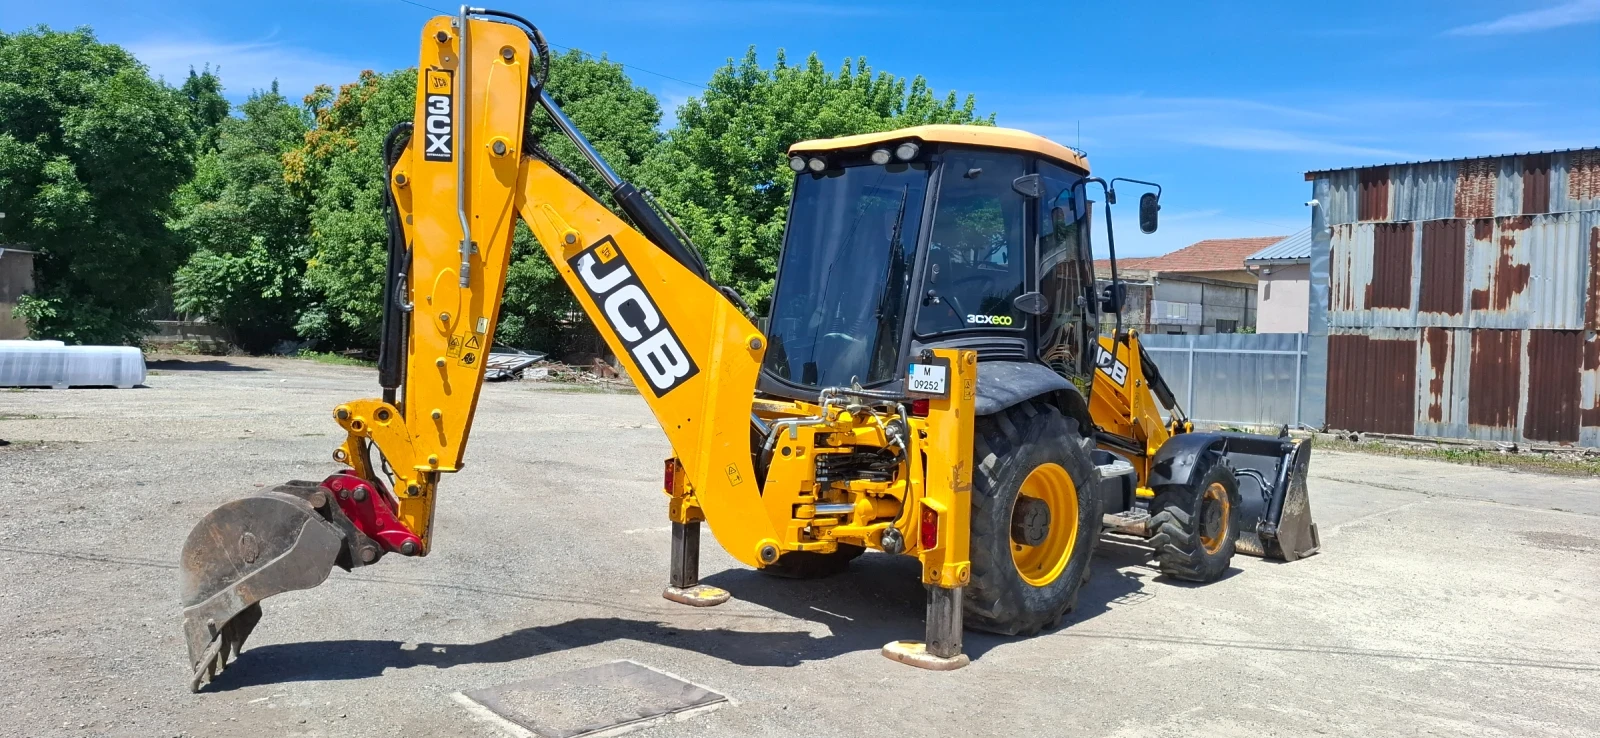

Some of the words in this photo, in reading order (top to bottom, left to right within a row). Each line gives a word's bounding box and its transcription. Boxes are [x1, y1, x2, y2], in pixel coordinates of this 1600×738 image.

[426, 95, 451, 153] 3CX
[577, 252, 690, 389] JCB
[967, 314, 1012, 326] 3CXeco
[924, 367, 931, 376] M
[914, 380, 939, 391] 09252
